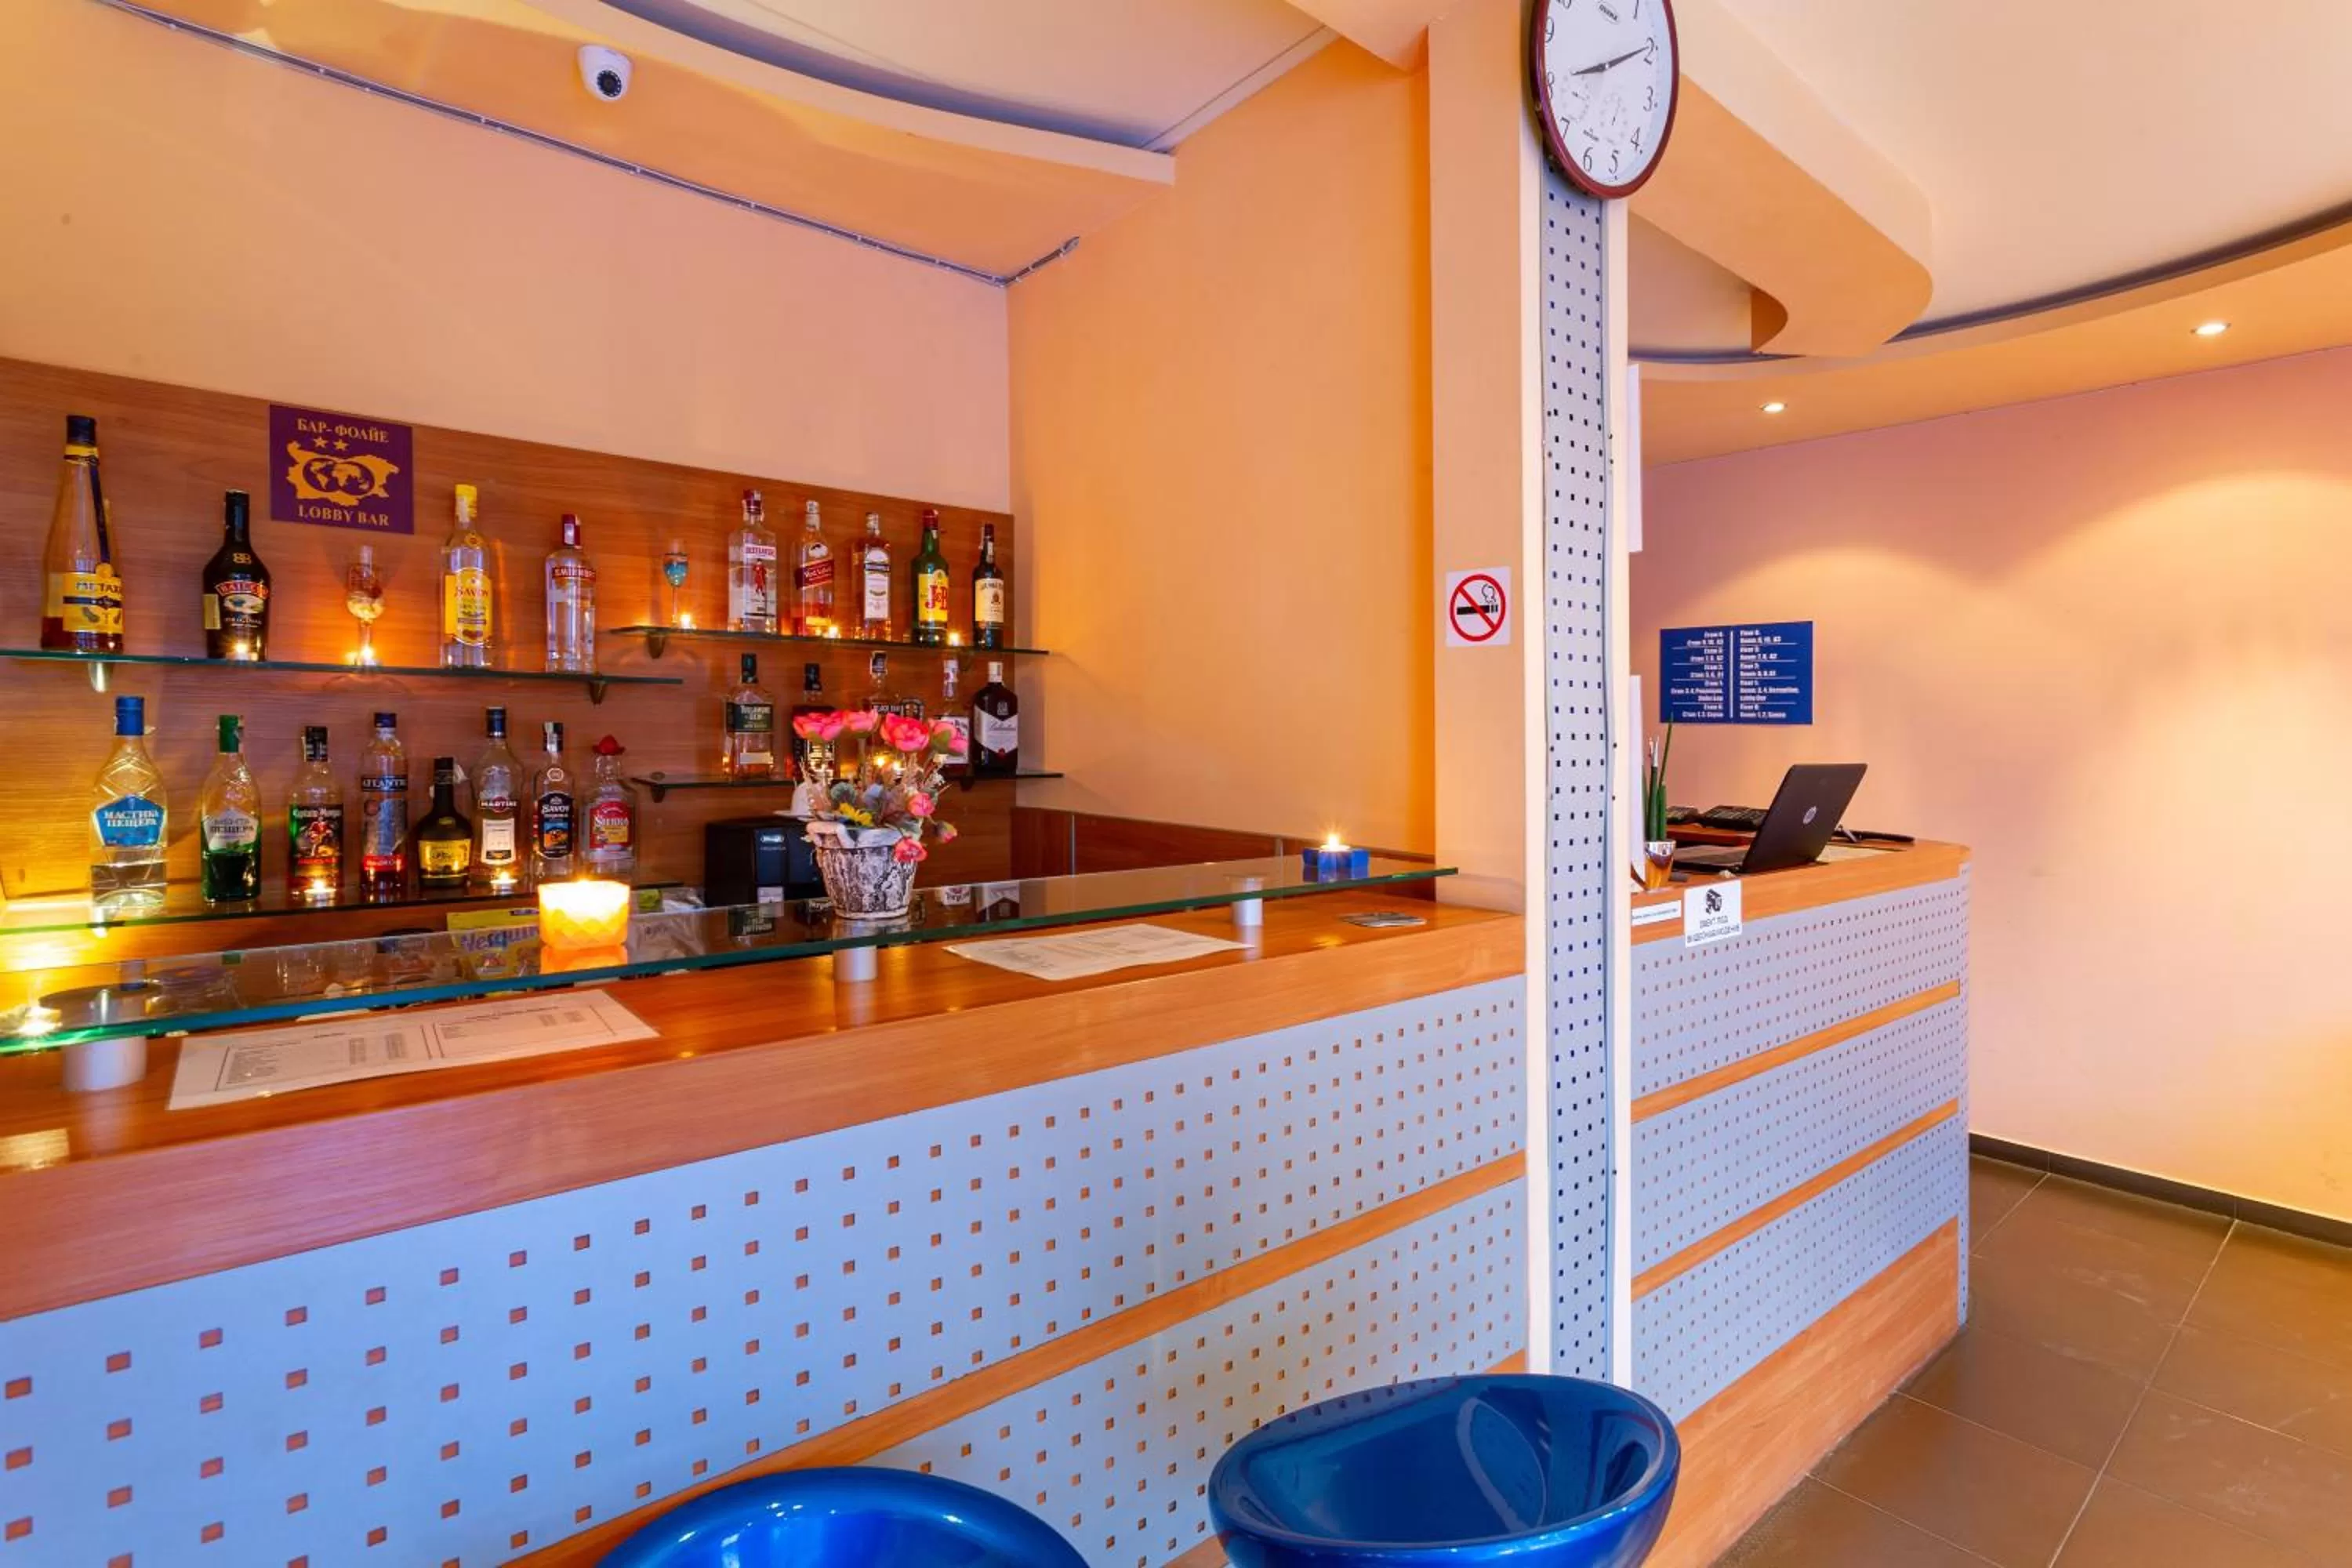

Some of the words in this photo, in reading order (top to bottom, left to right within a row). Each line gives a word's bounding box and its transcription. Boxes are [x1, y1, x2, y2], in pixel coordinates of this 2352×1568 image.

[1643, 37, 1655, 65] 2
[1643, 85, 1654, 111] 3
[1560, 117, 1570, 138] 7
[1630, 126, 1641, 151] 4
[1583, 147, 1594, 172] 6
[1608, 150, 1621, 174] 5
[298, 504, 354, 524] LOBBY
[358, 511, 390, 527] BAR
